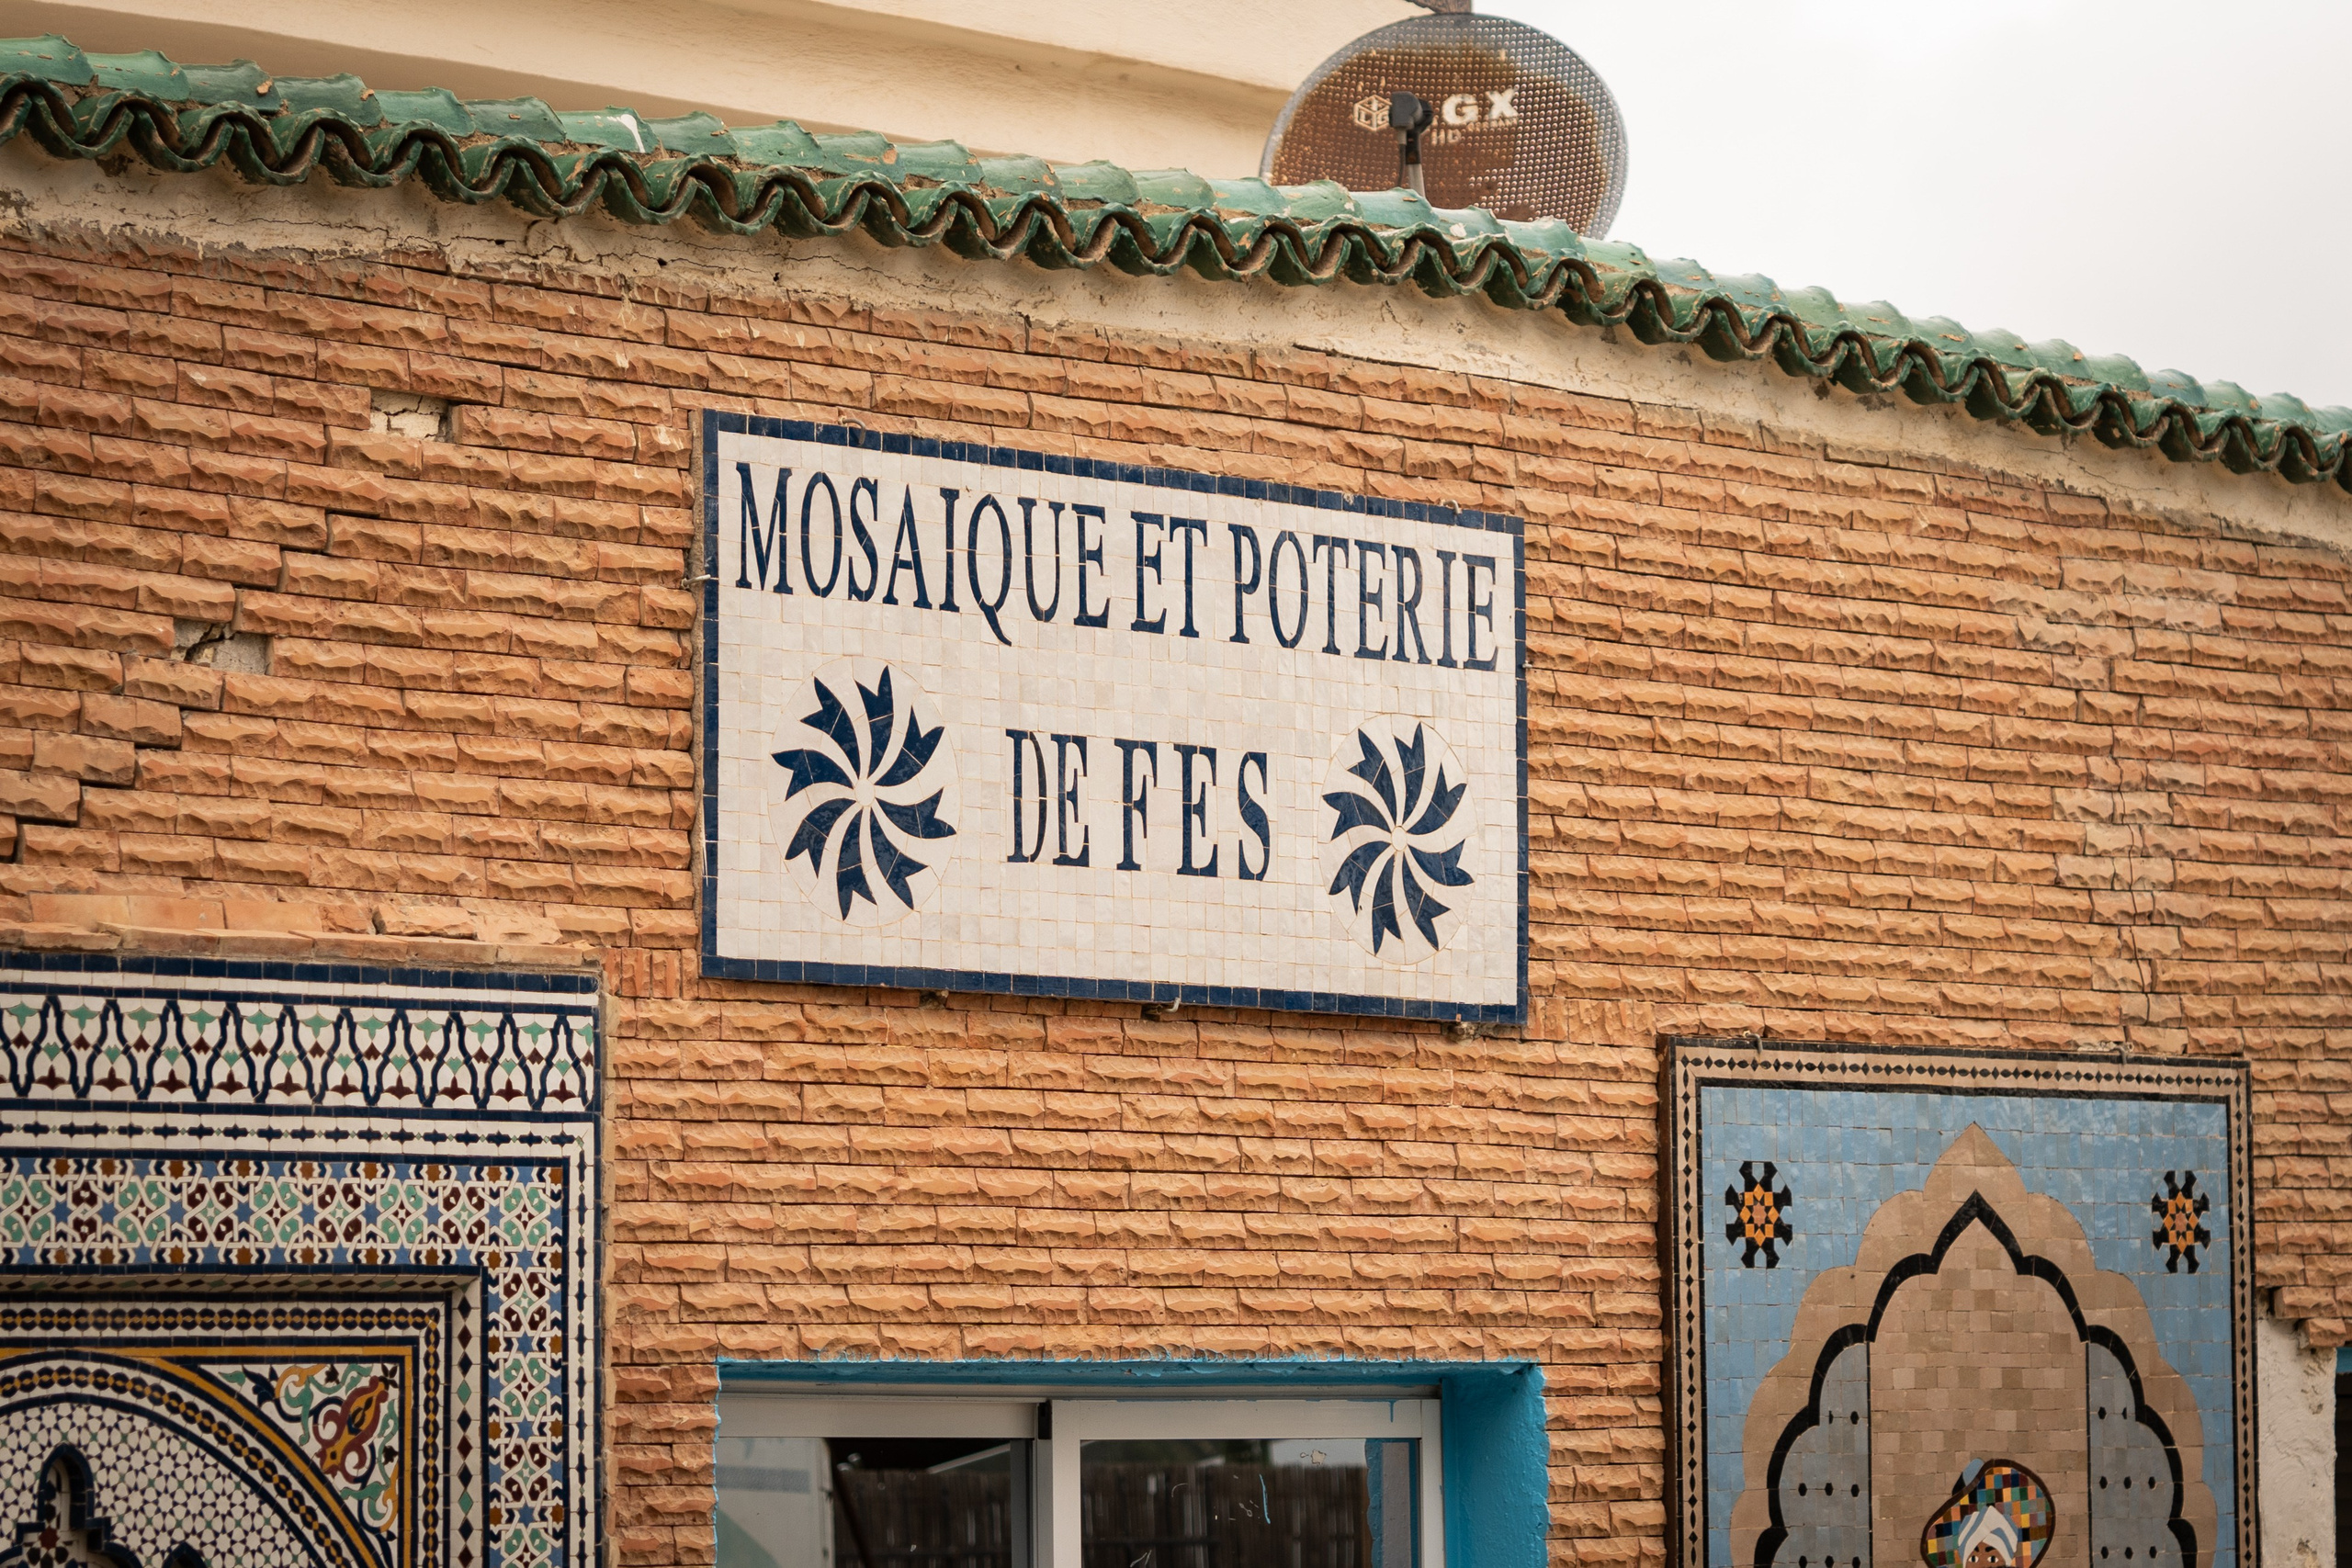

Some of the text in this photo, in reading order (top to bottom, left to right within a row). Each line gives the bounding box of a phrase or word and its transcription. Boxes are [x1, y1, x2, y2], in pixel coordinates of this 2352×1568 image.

[736, 462, 1498, 671] MOSAIQUE ET POTERIE
[1005, 728, 1270, 881] DE FES
